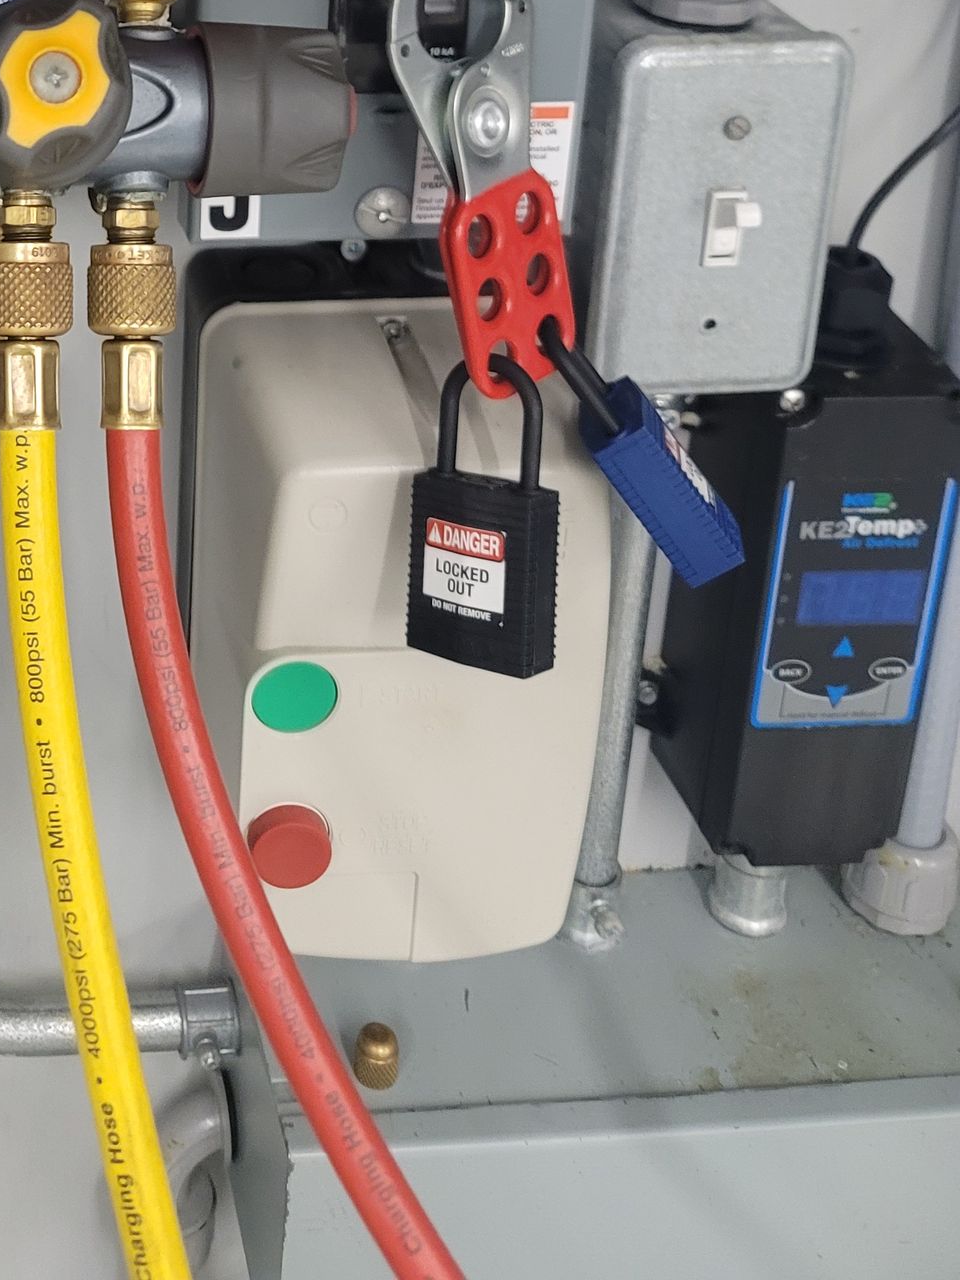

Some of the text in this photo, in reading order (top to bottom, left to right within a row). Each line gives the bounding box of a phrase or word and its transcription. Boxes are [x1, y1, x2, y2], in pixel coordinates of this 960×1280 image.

[15, 479, 30, 529] Max.
[16, 537, 36, 582] Bar)
[138, 524, 153, 573] Max.
[443, 525, 500, 557] DANGER
[436, 558, 489, 584] LOCKED
[448, 579, 474, 598] OUT
[20, 589, 40, 624] (55
[142, 580, 161, 622] Bar)
[432, 598, 491, 622] DO NOT REMOVE
[153, 625, 171, 659] (55
[23, 631, 44, 703] 800psi
[158, 666, 188, 732] 800psi
[36, 740, 61, 795] burst
[187, 764, 216, 820] burst
[44, 802, 64, 849] Min.
[53, 858, 73, 902] Bar)
[64, 910, 87, 961] (275
[76, 970, 100, 1059] 4000psi
[102, 1102, 124, 1164] Hose
[326, 1090, 361, 1151] Hose
[117, 1174, 152, 1280] Charging
